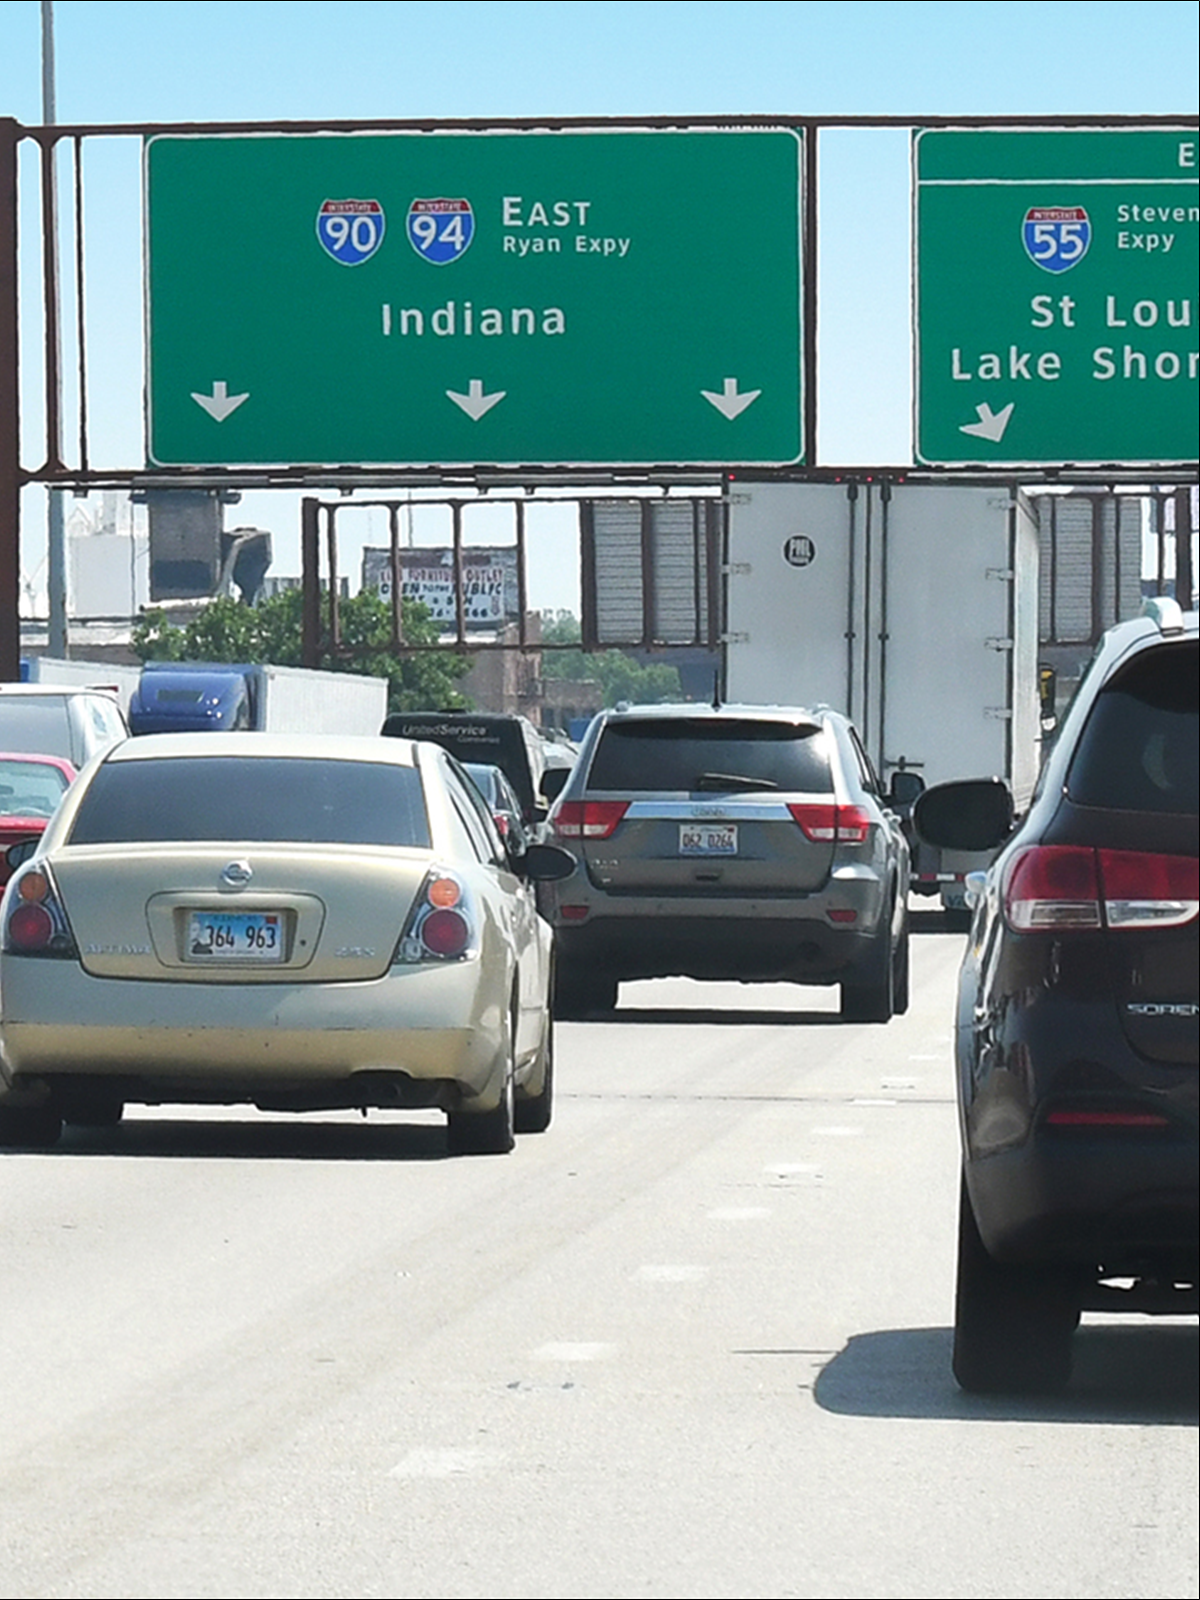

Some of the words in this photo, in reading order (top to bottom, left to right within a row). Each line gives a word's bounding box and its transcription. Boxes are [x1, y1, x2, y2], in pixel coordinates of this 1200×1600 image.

[502, 196, 591, 227] EAST
[325, 216, 377, 252] 90
[412, 215, 466, 251] 94
[502, 235, 561, 258] Ryan
[575, 235, 631, 258] Expy
[1033, 224, 1085, 260] 55
[1117, 231, 1175, 253] Expy
[382, 300, 566, 336] Indiana
[1030, 295, 1076, 328] St
[1106, 295, 1191, 328] Lou
[951, 345, 1062, 381] Lake
[205, 924, 235, 948] 364
[245, 925, 276, 949] 963
